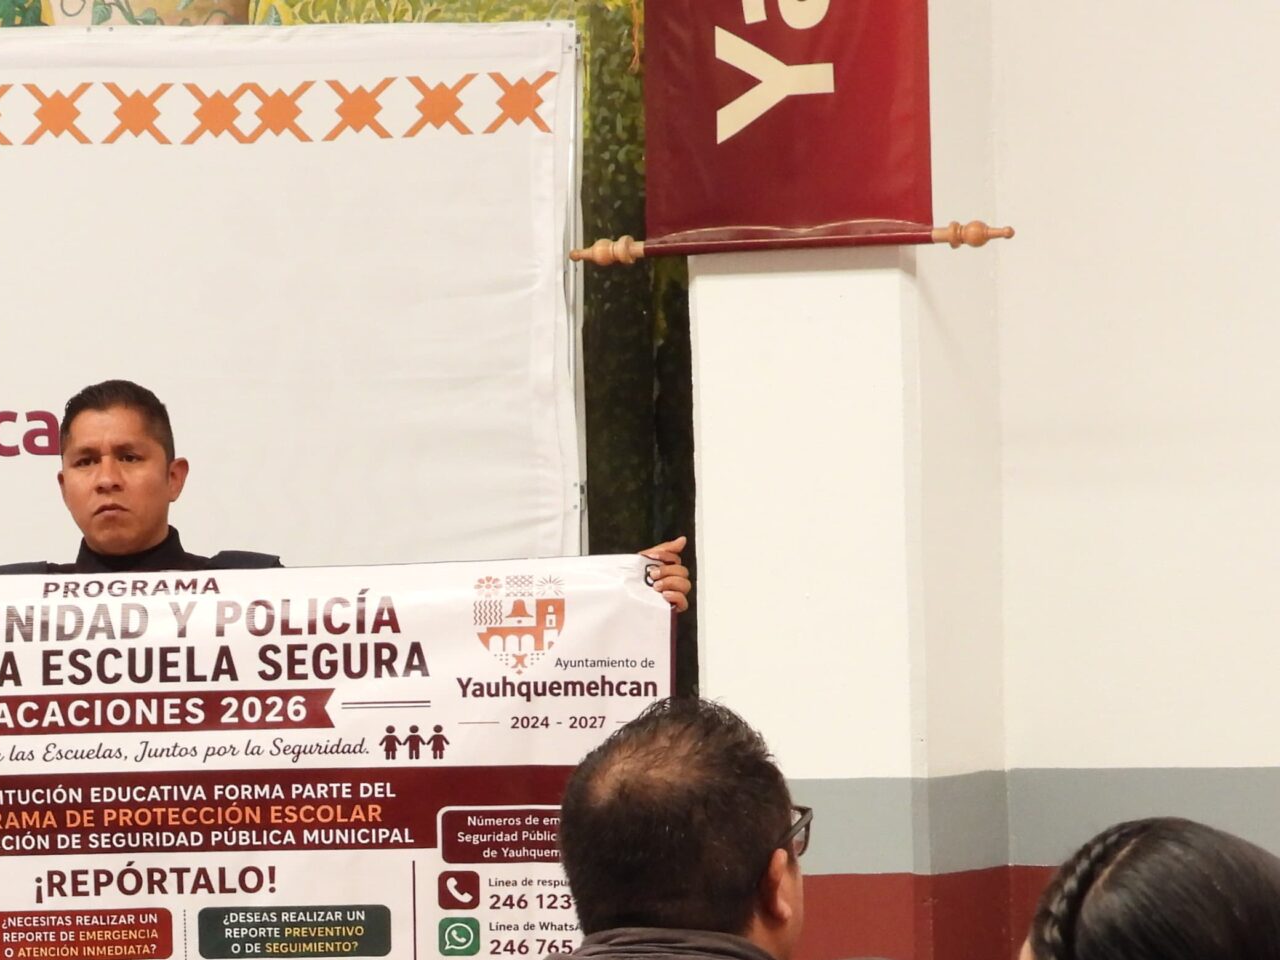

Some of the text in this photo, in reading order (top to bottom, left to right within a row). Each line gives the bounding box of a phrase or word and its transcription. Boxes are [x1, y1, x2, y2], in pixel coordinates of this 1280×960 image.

[42, 577, 221, 599] PROGRAMA
[168, 599, 198, 638] Y
[214, 588, 402, 636] POLICÍA
[41, 645, 239, 686] ESCUELA
[257, 640, 431, 681] SEGURA
[554, 657, 656, 671] Ayuntamiento de
[456, 675, 659, 702] Yauhquemehcan
[220, 695, 308, 723] 2026
[510, 716, 550, 729] 2024
[569, 716, 607, 729] 2027
[9, 744, 35, 762] las
[42, 740, 129, 763] Escuelas,
[133, 738, 198, 764] Juntos
[203, 741, 240, 763] por
[243, 738, 264, 757] la
[268, 736, 370, 762] Seguridad.
[90, 783, 208, 803] EDUCATIVA
[214, 783, 284, 800] FORMA
[291, 782, 352, 799] PARTE
[358, 781, 397, 798] DEL
[66, 809, 97, 828] DE
[103, 801, 261, 827] PROTECCIÓN
[269, 804, 383, 824] ESCOLAR
[467, 815, 561, 827] Números de em
[57, 834, 82, 850] DE
[88, 829, 205, 850] SEGURIDAD
[209, 825, 297, 846] PÚBLICA
[303, 826, 415, 845] MUNICIPAL
[457, 830, 557, 844] Seguridad Públic
[482, 847, 561, 862] de Yauhquem
[35, 862, 278, 903] ¡REPÓRTALO!
[488, 877, 571, 889] Línea de respu
[489, 893, 572, 910] 246 123
[1, 912, 159, 931] ¿NECESITAS REALIZAR UN
[222, 909, 366, 925] ¿DESEAS REALIZAR UN
[224, 923, 365, 939] REPORTE PREVENTIVO
[488, 921, 582, 932] Línea de WhatsA
[2, 927, 159, 944] REPORTE DE EMERGENCIA
[4, 942, 157, 959] O ATENCIÓN INMEDIATA?
[231, 940, 359, 954] O DE SEGUIMIENTO?
[489, 938, 573, 955] 246 765
